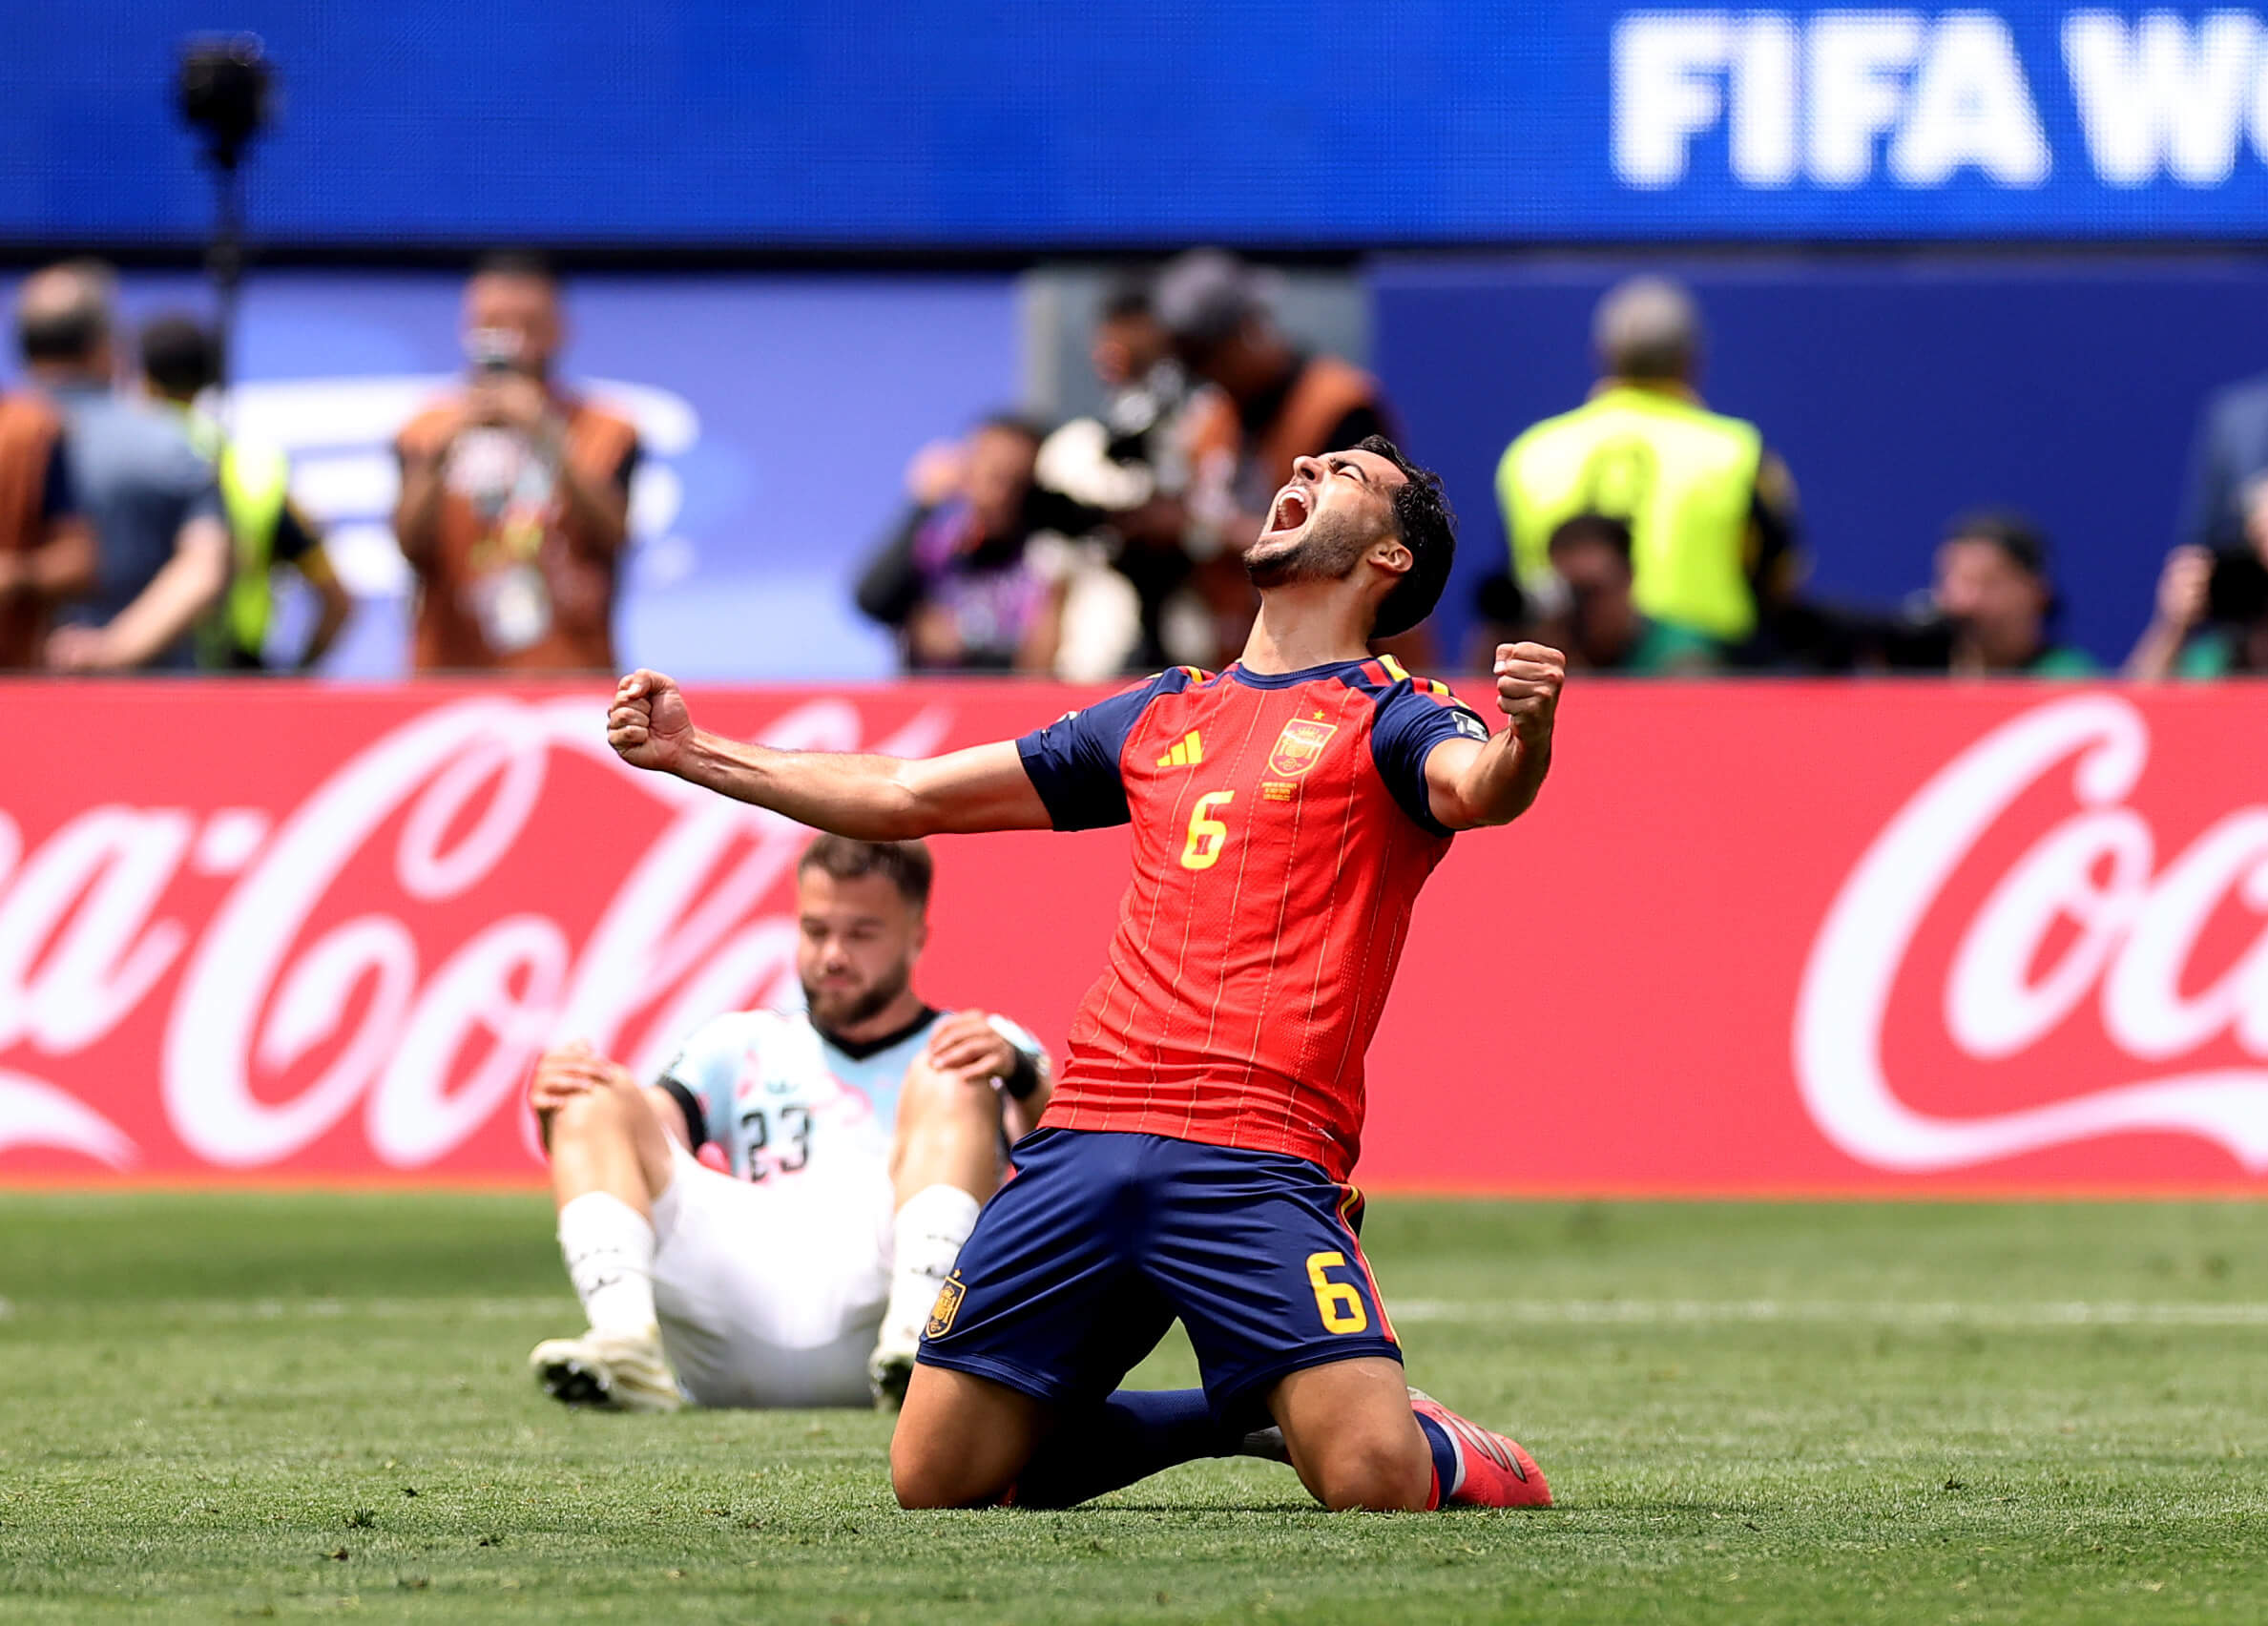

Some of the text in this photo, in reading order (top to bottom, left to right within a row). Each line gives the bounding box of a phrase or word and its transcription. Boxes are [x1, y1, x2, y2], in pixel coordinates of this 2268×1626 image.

[1611, 9, 2268, 188] FIFA W
[1180, 789, 1236, 870] 6
[1792, 693, 2268, 1170] Coc
[740, 1102, 813, 1183] 23
[1305, 1250, 1369, 1335] 6
